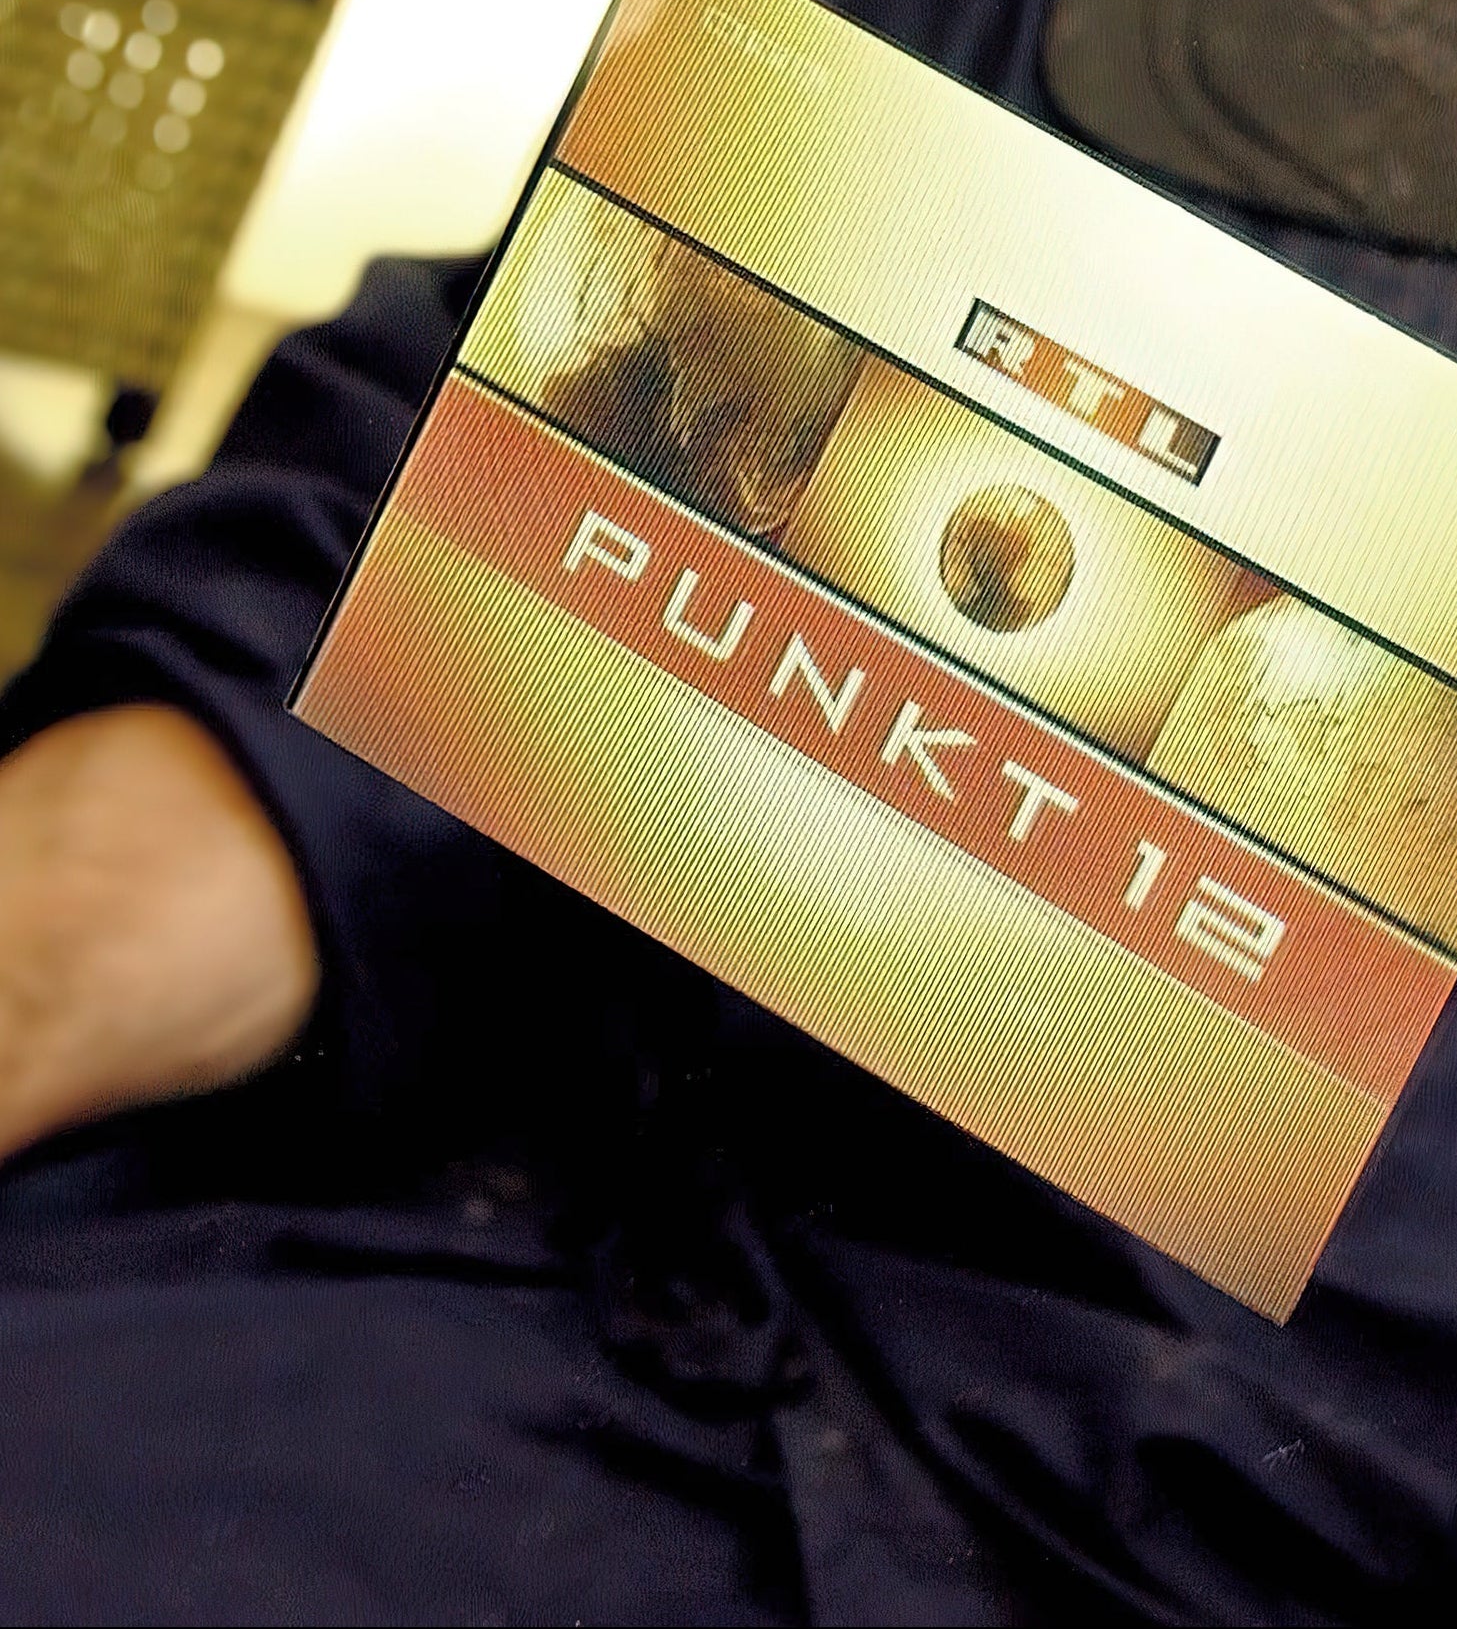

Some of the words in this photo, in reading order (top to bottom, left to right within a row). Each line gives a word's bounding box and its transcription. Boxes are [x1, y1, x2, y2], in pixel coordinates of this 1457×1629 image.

[958, 301, 1203, 479] RTL
[562, 510, 1079, 844] PUNKT
[1121, 837, 1286, 984] 12
